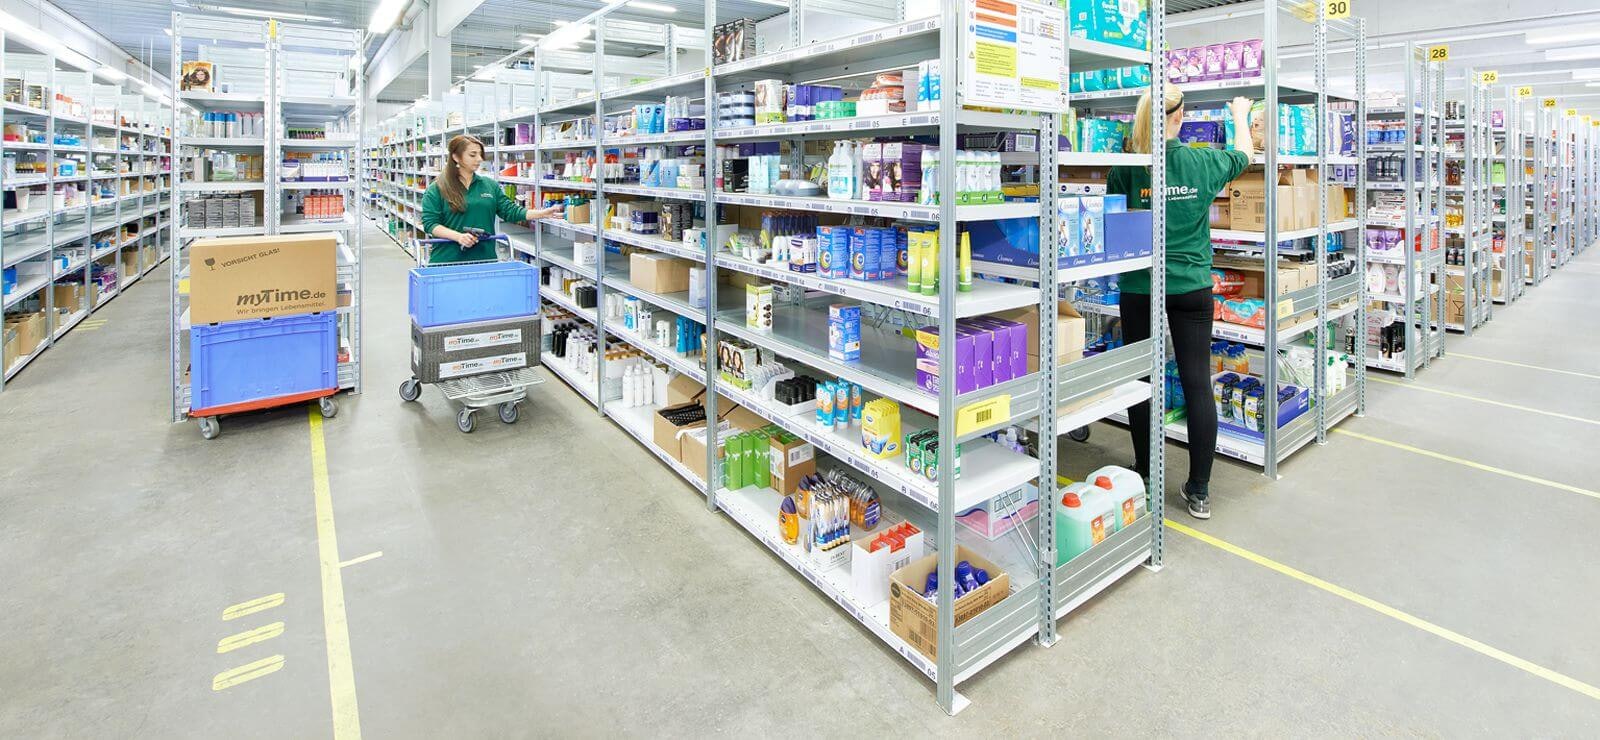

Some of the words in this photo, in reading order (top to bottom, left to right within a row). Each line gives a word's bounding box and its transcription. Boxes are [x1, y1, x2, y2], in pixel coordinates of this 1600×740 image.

[1328, 2, 1346, 15] 30
[927, 20, 936, 30] 06
[1432, 48, 1446, 58] 28
[930, 116, 939, 124] 06
[870, 207, 878, 215] 05
[931, 213, 940, 221] 06
[221, 254, 257, 268] VORSICHT
[258, 248, 280, 258] GLAS!
[236, 289, 326, 306] myTime.de
[252, 306, 278, 314] bringen
[922, 306, 932, 316] 06
[870, 469, 879, 479] 05
[928, 668, 936, 680] 05
